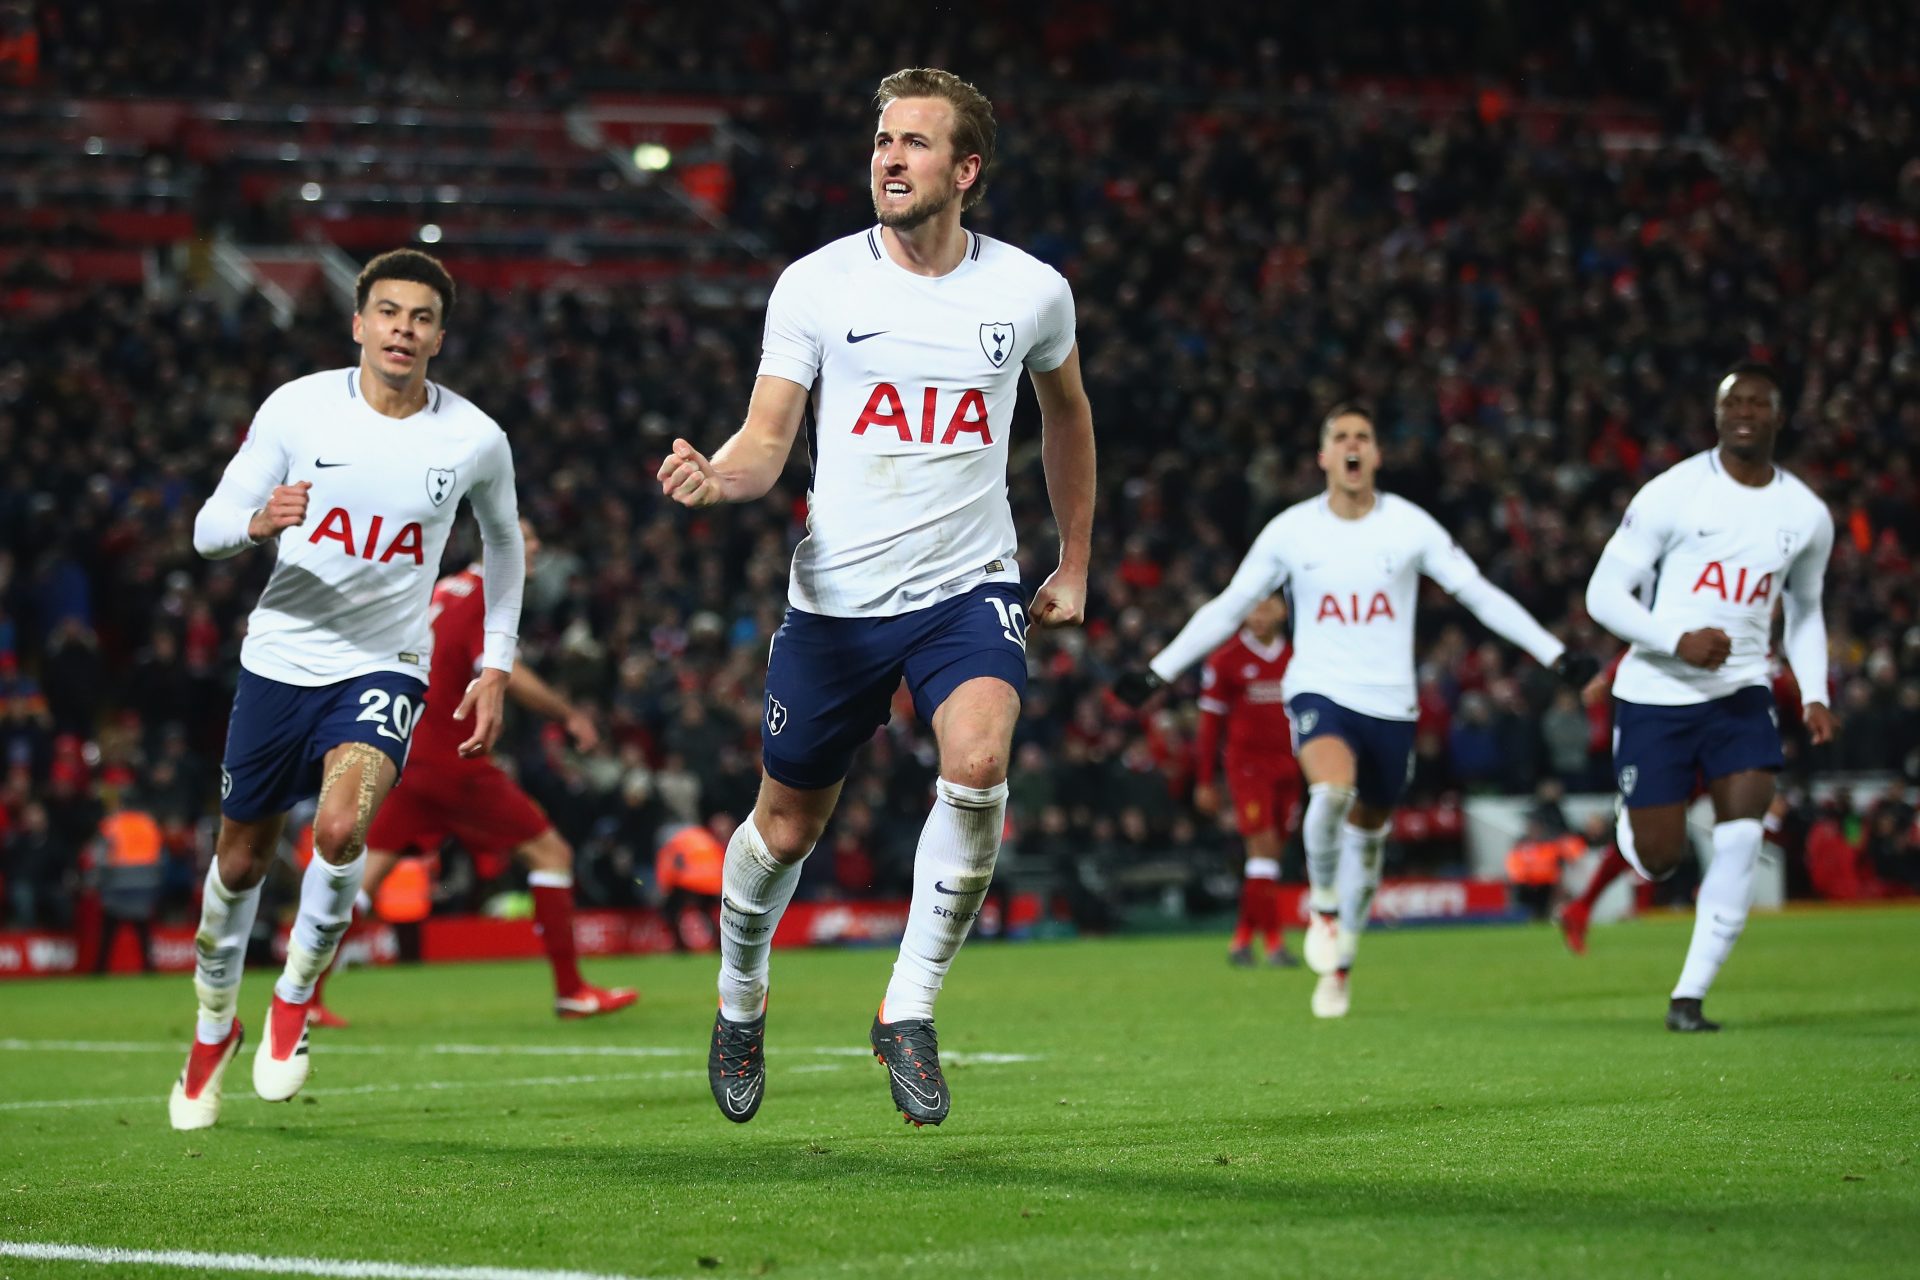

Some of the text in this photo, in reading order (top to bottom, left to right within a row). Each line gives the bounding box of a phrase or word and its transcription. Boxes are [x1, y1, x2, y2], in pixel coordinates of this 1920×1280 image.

[851, 383, 993, 445] AIA
[309, 507, 423, 564] AIA
[1316, 591, 1395, 625] AIA
[1692, 561, 1774, 605] AIA
[355, 688, 413, 740] 20
